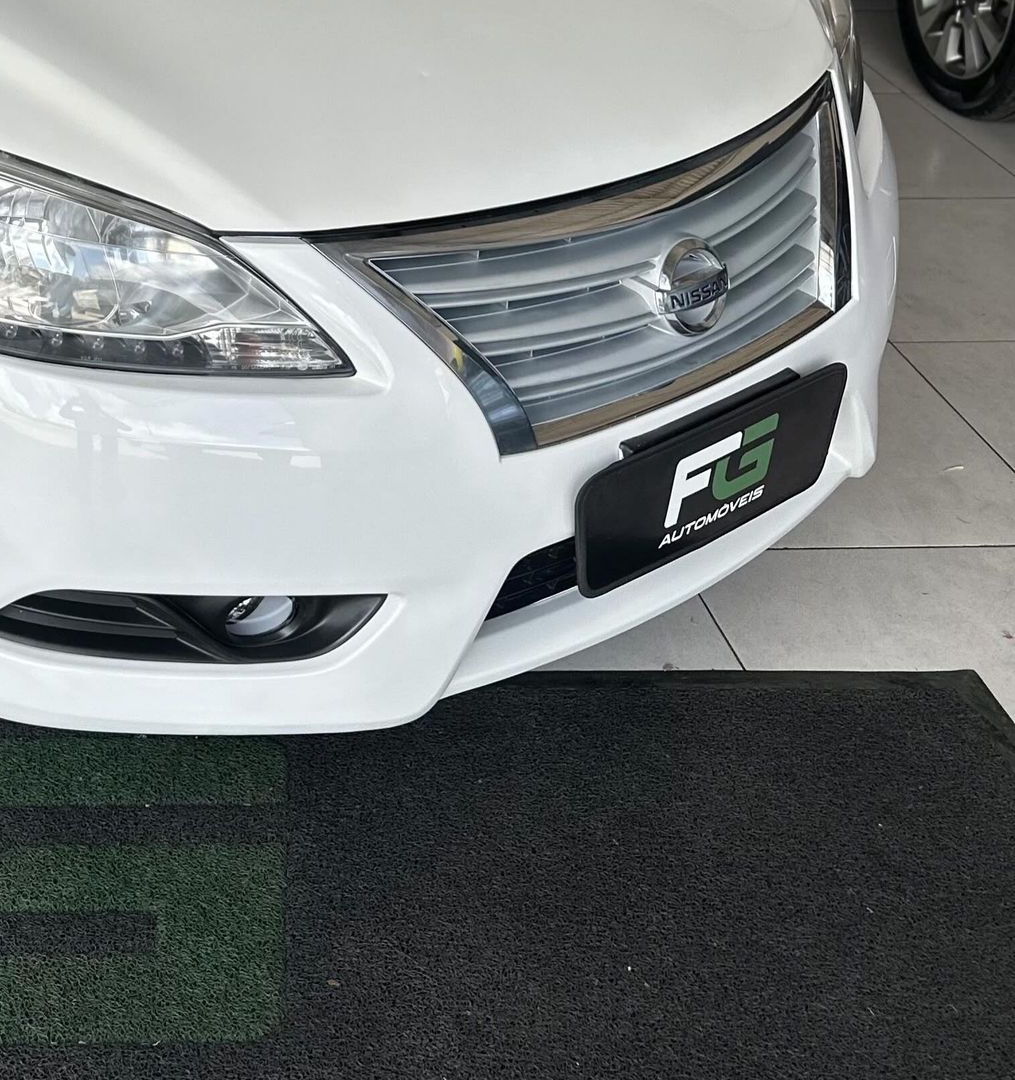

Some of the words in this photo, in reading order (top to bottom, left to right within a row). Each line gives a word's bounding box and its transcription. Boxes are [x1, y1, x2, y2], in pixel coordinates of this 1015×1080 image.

[669, 277, 728, 310] NISSAN
[663, 412, 780, 529] FG
[658, 484, 766, 549] AUTOMÓVEIS
